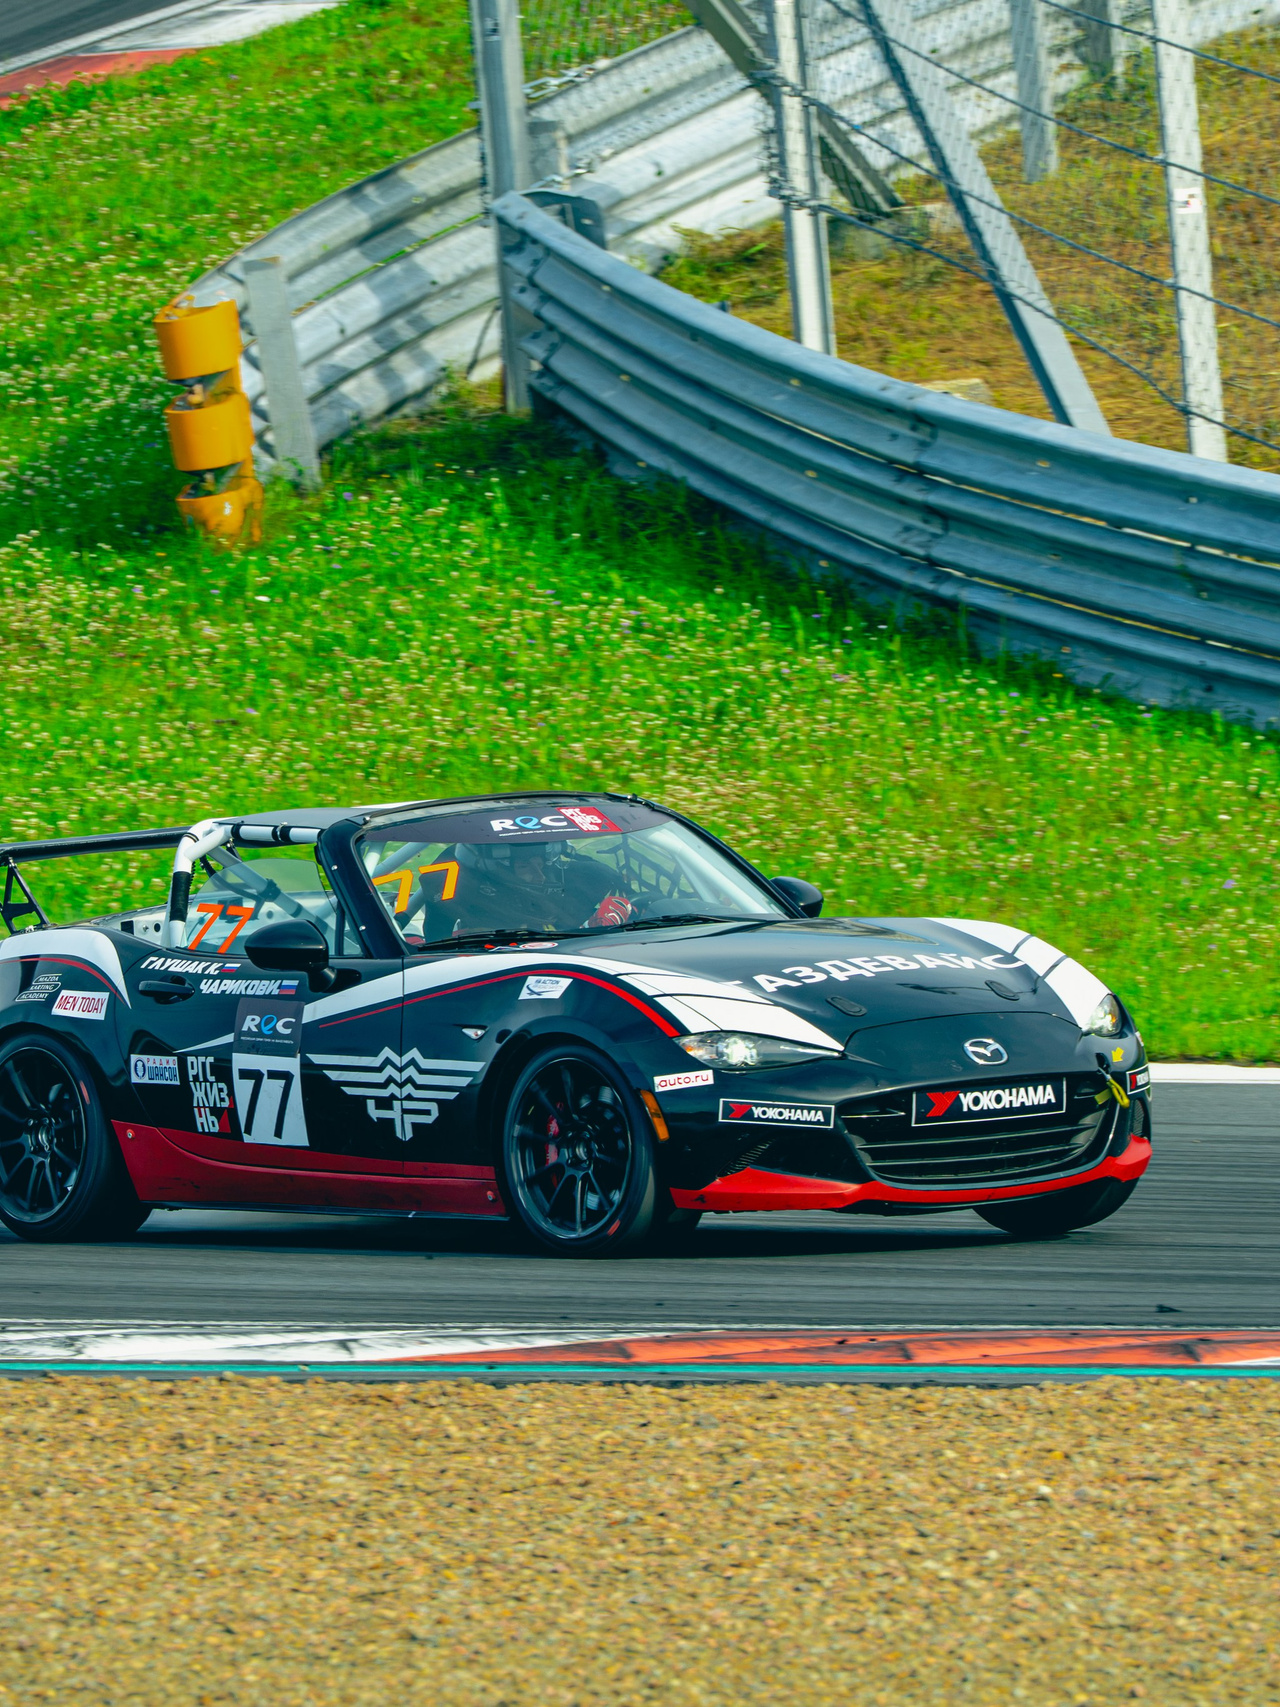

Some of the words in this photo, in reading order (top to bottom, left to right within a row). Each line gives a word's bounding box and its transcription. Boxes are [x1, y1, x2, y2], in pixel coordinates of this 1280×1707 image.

[371, 861, 460, 914] 77
[187, 903, 255, 954] 77
[140, 956, 211, 974] ГЛУШАК
[55, 995, 79, 1012] MEN
[77, 996, 106, 1014] TODAY
[146, 1058, 177, 1066] РАДИО
[147, 1065, 178, 1081] ШАНСОН
[186, 1056, 216, 1081] РГС
[658, 1072, 709, 1088] auto.ru
[190, 1082, 230, 1108] ЖИЗ
[237, 1068, 295, 1140] 77
[958, 1084, 1057, 1112] YOKOHAMA
[193, 1107, 220, 1132] НЬ
[751, 1105, 825, 1123] YOKOHAMA
